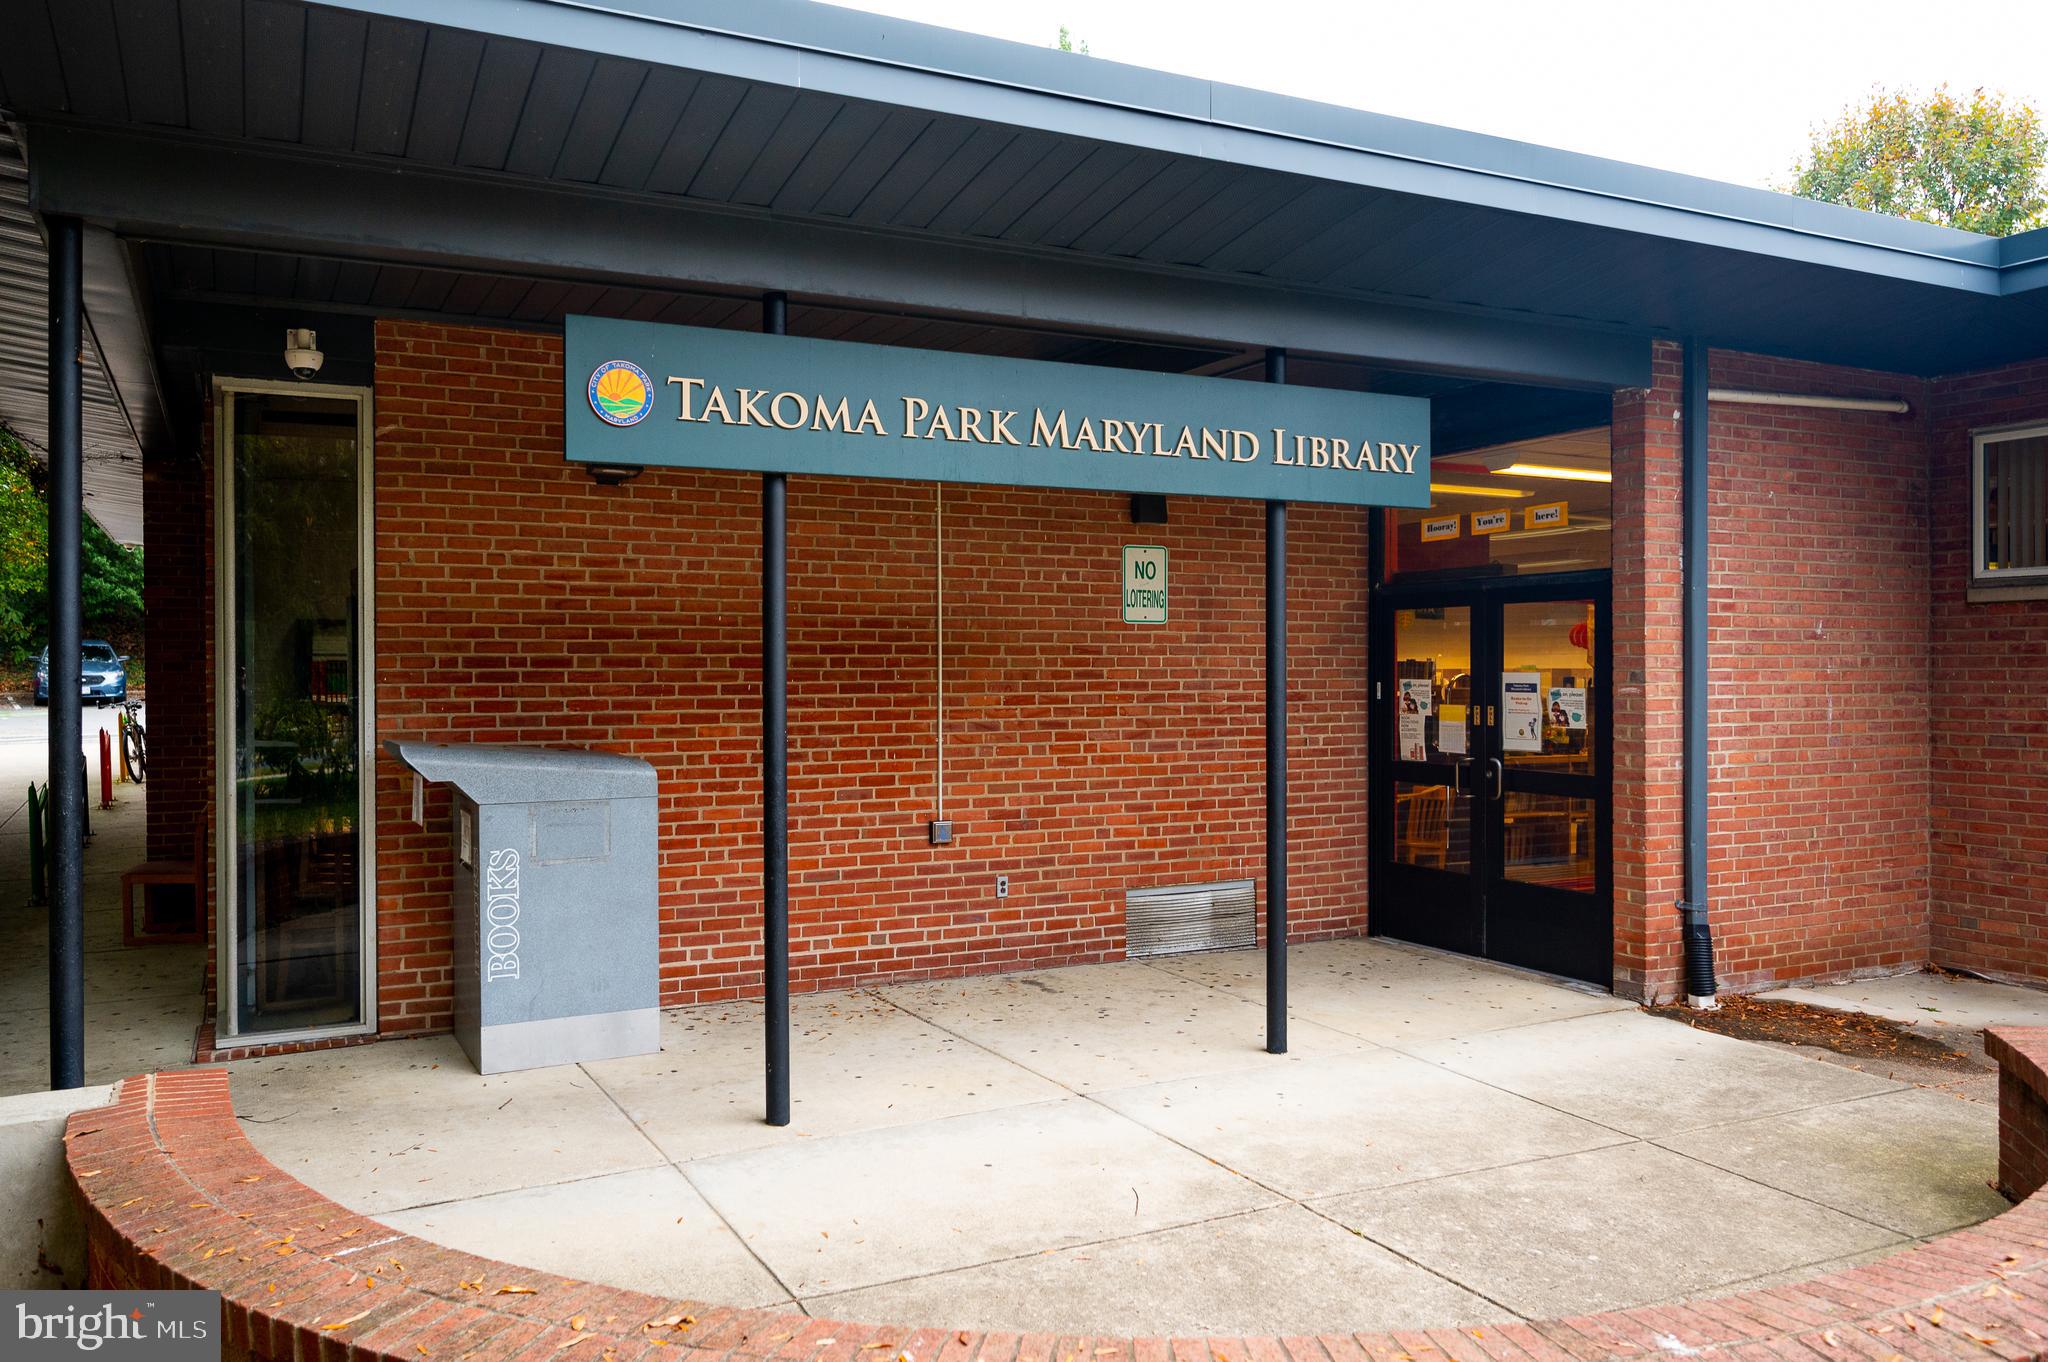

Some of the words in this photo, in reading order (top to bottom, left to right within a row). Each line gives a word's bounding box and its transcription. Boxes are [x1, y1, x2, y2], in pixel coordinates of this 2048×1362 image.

[591, 373, 601, 388] CITY
[600, 364, 609, 373] OF
[612, 362, 639, 375] TAKOMA
[640, 374, 651, 392] PARK
[604, 413, 639, 425] MARYLAND
[1476, 515, 1505, 526] You're
[1535, 508, 1558, 521] here!
[1427, 520, 1457, 533] Hooray!
[1134, 560, 1157, 580] NO
[1126, 588, 1165, 609] LOITERING
[487, 848, 520, 983] BOOKS
